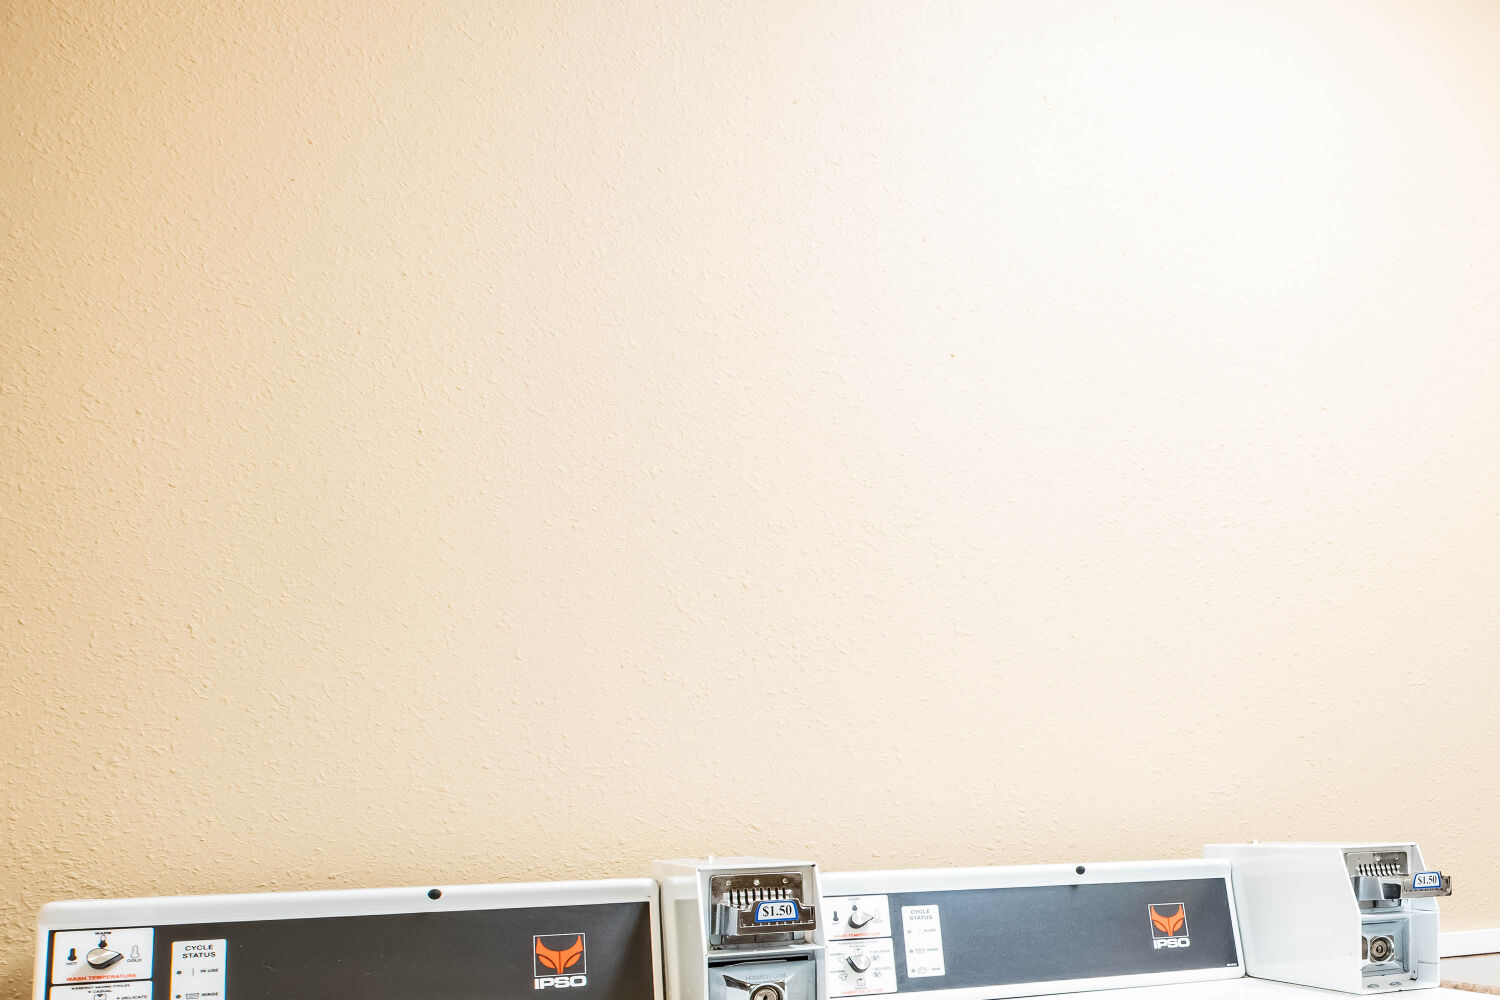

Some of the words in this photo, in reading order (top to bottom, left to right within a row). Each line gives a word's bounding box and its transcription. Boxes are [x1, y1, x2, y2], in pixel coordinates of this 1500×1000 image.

[1418, 874, 1437, 885] $1.50
[762, 904, 792, 917] $1.50
[1153, 938, 1190, 949] IPSO
[534, 975, 587, 990] IPSO
